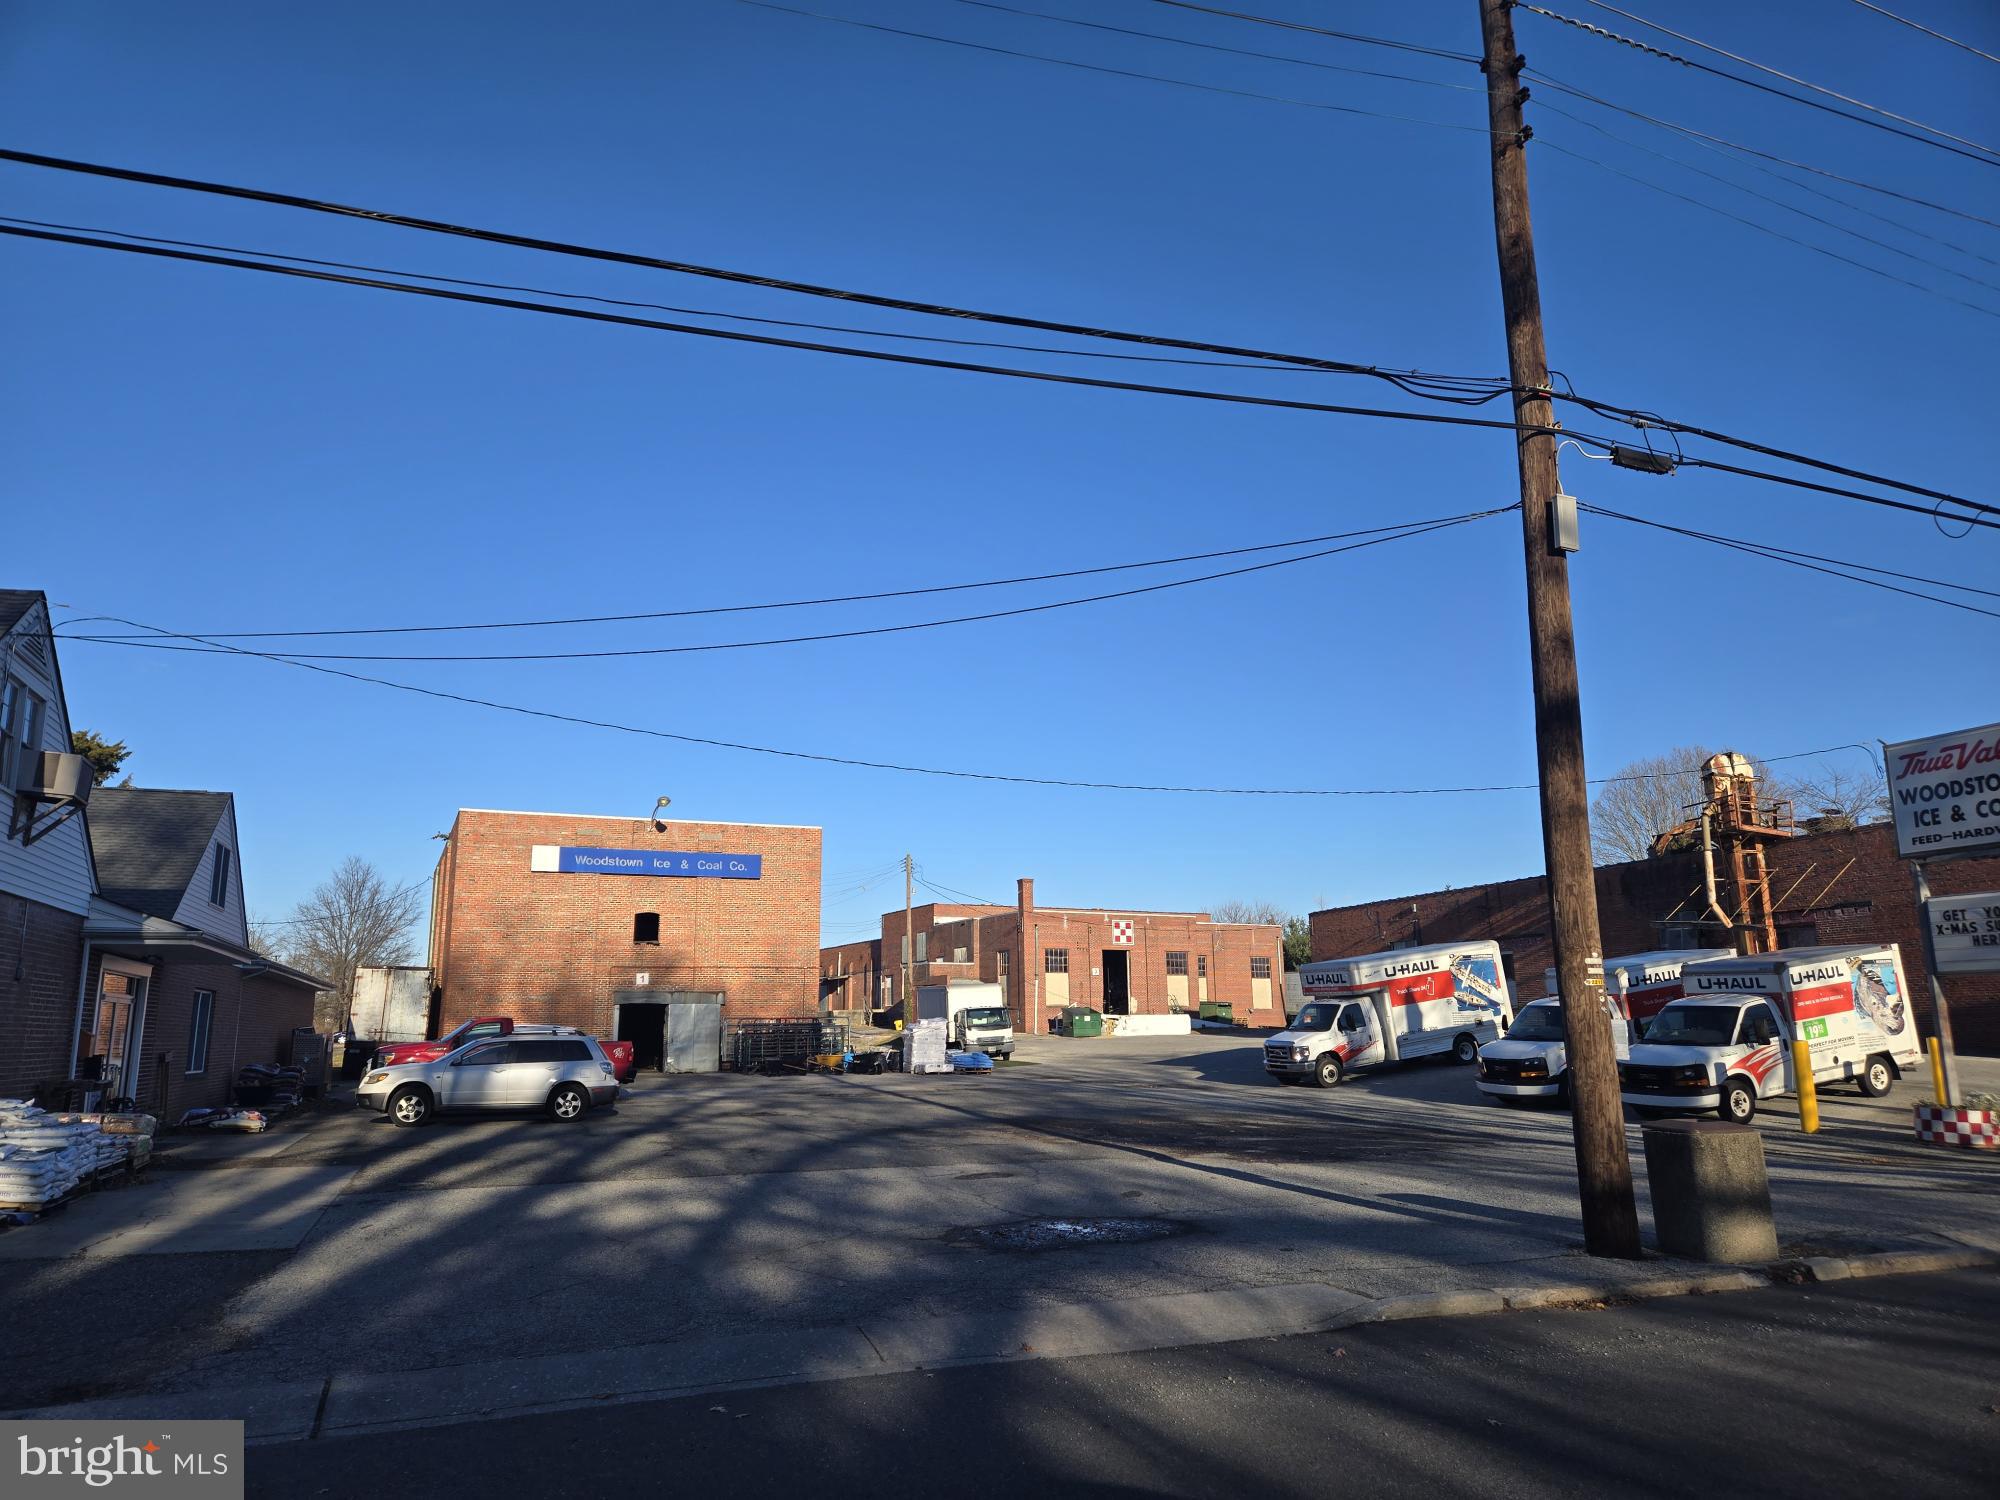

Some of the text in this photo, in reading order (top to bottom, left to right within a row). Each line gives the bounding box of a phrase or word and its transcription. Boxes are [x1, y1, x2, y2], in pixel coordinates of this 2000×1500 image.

[1896, 750, 1954, 780] True
[1898, 773, 2000, 805] WOODSTO
[1914, 798, 2000, 827] ICE & CO
[575, 855, 748, 871] Woodstown Ice & Coal Co.
[1943, 909, 1967, 921] GET
[1936, 921, 1978, 935] X-MAS
[1972, 934, 2000, 946] HER
[1385, 960, 1439, 977] U-HAUL
[1790, 965, 1844, 985] U-HAUL
[1306, 973, 1346, 985] U-HAUL
[1628, 969, 1681, 987] U-HAUL
[1697, 977, 1766, 989] U-HAUL
